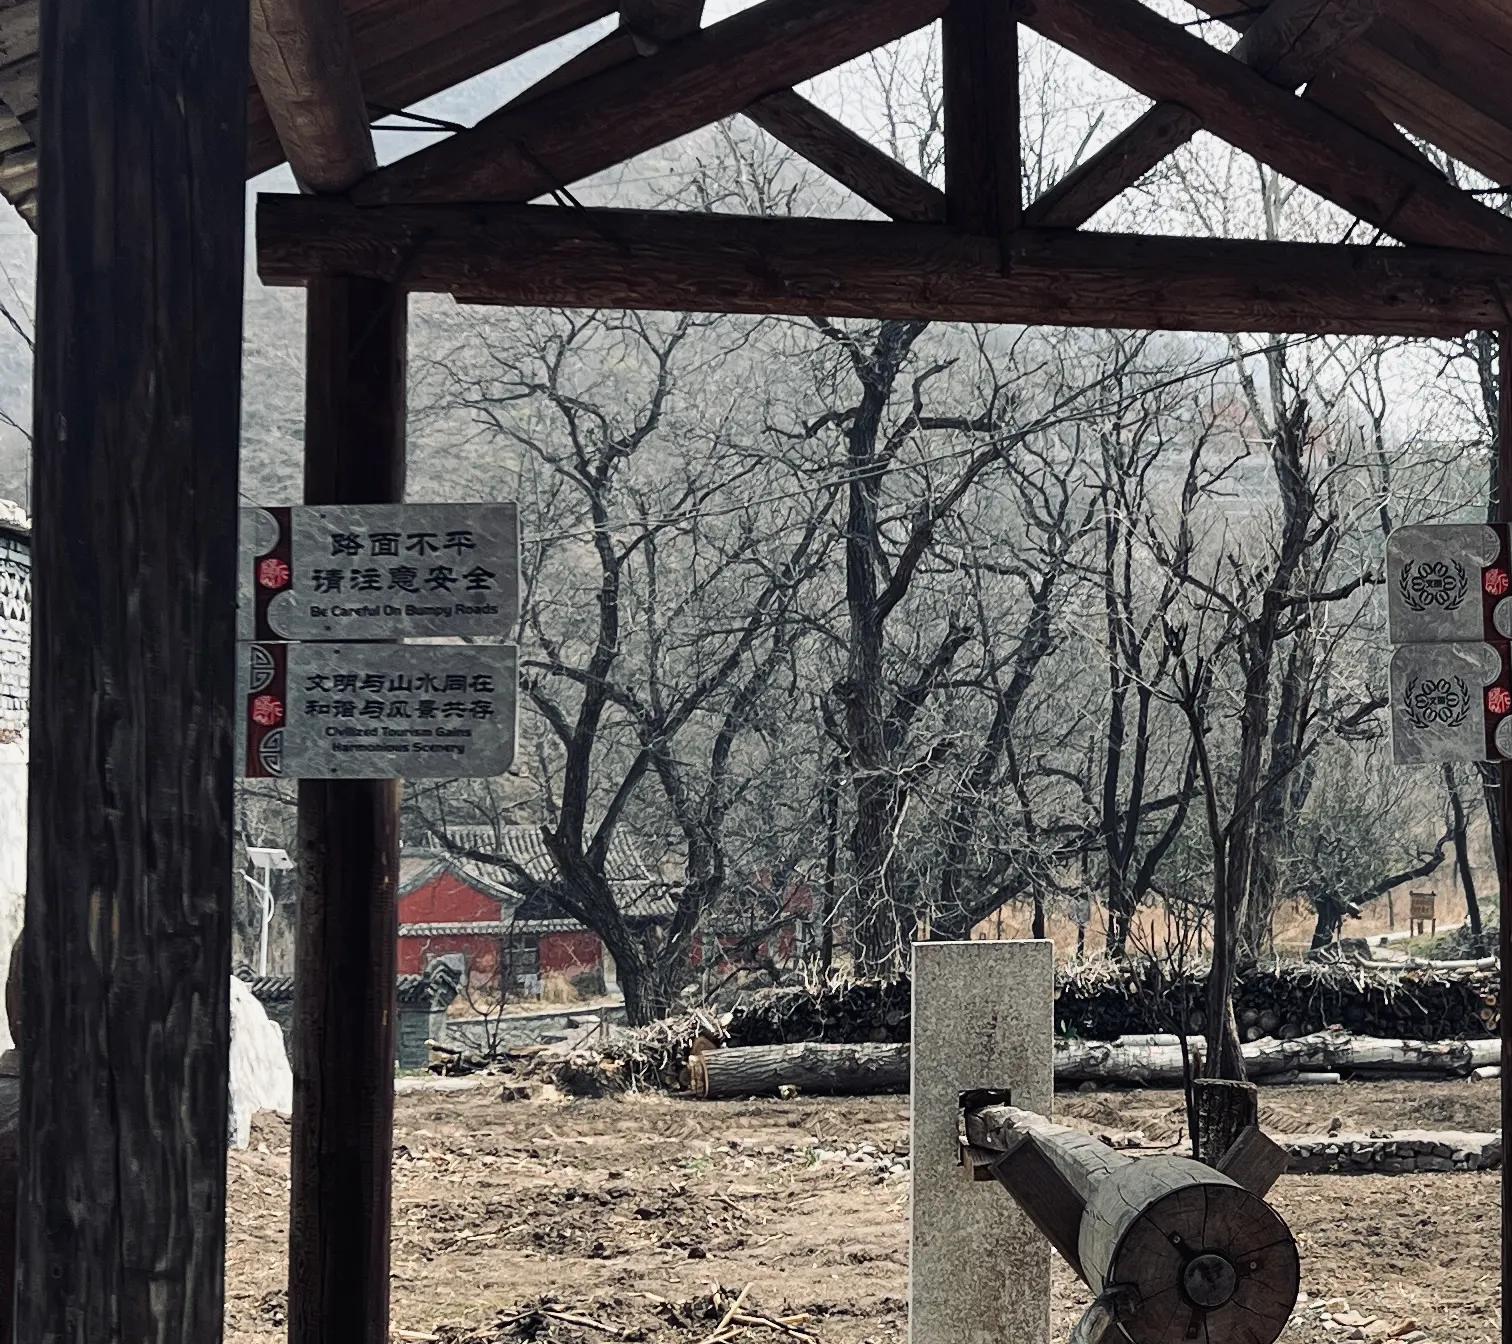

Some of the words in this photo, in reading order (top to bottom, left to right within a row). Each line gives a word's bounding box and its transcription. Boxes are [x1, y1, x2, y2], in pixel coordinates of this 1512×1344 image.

[331, 530, 476, 556] 路面不平
[311, 565, 496, 593] 请注意安全
[310, 605, 327, 617] Be
[331, 605, 380, 617] Careful
[383, 605, 400, 616] On
[405, 605, 451, 617] Bumpy
[455, 603, 498, 615] Roads
[305, 672, 495, 693] 文明与山水同在
[304, 700, 494, 719] 和谐与风景共存
[325, 726, 378, 737] Civilized
[381, 726, 433, 737] Tourism
[435, 726, 472, 737] Gains
[332, 742, 409, 752] Harmonious
[412, 742, 465, 754] Scenery
